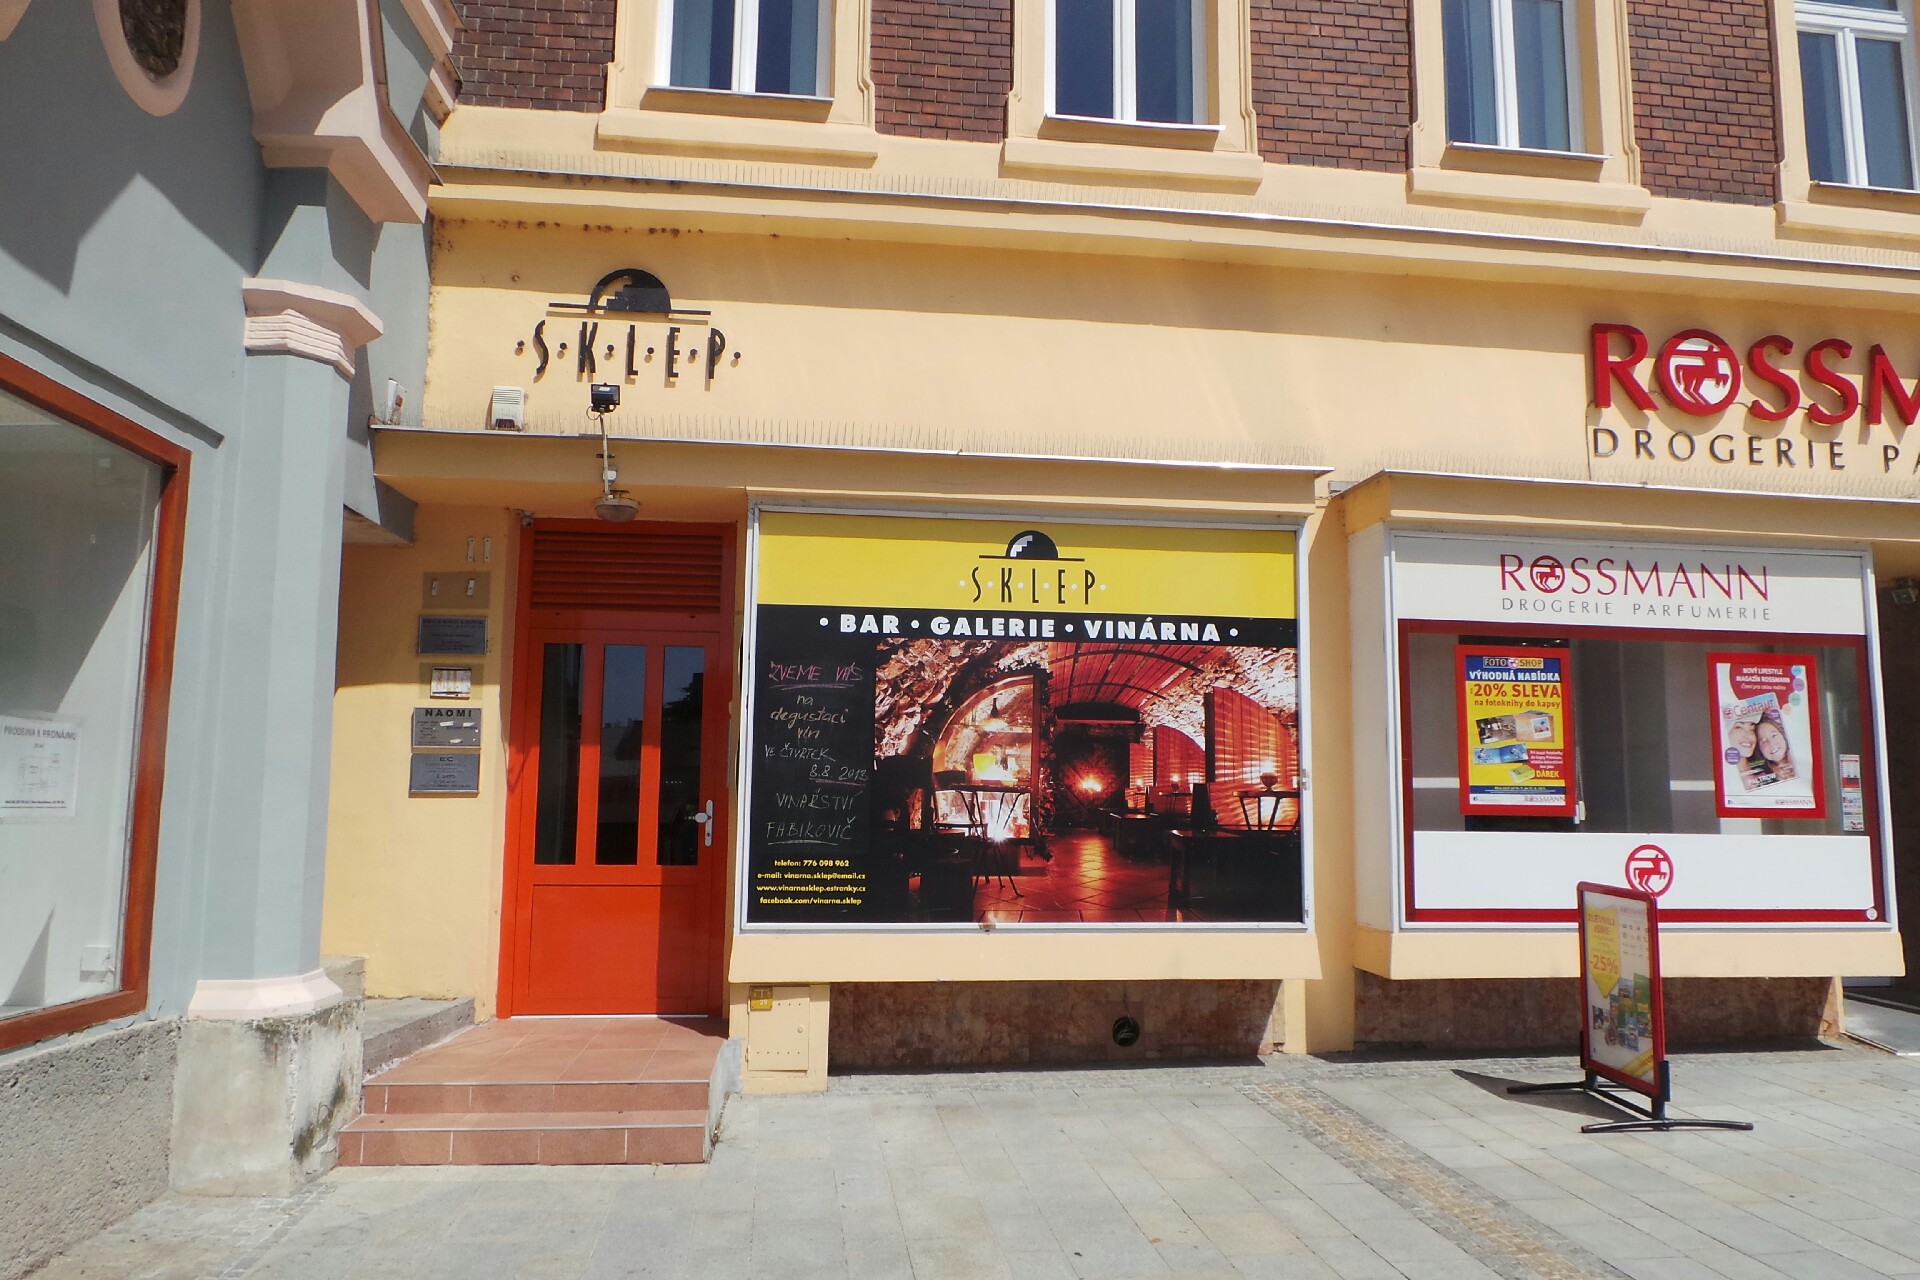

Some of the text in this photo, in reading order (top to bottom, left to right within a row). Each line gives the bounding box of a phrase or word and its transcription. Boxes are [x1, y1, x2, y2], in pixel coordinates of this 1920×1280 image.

[1592, 427, 1846, 471] DROGERIE
[1500, 554, 1770, 601] ROSSMANN
[1502, 597, 1771, 621] DROGERIE PARFUMERIE
[840, 613, 1221, 642] BAR GALERIE VINÁRNA
[1484, 658, 1543, 667] FOTO SHOP
[769, 661, 822, 681] ZVEME
[1469, 670, 1561, 681] VÝHODNÁ NABÍDKA
[1473, 683, 1561, 698] 20% SLEVA
[797, 695, 814, 705] na
[1486, 699, 1523, 708] fotoknihy
[1537, 700, 1561, 709] kapsy
[425, 709, 472, 717] NAOMI
[770, 706, 849, 729] degustaci
[765, 744, 776, 757] VE
[838, 766, 869, 781] 2013
[1536, 769, 1559, 778] DÁREK
